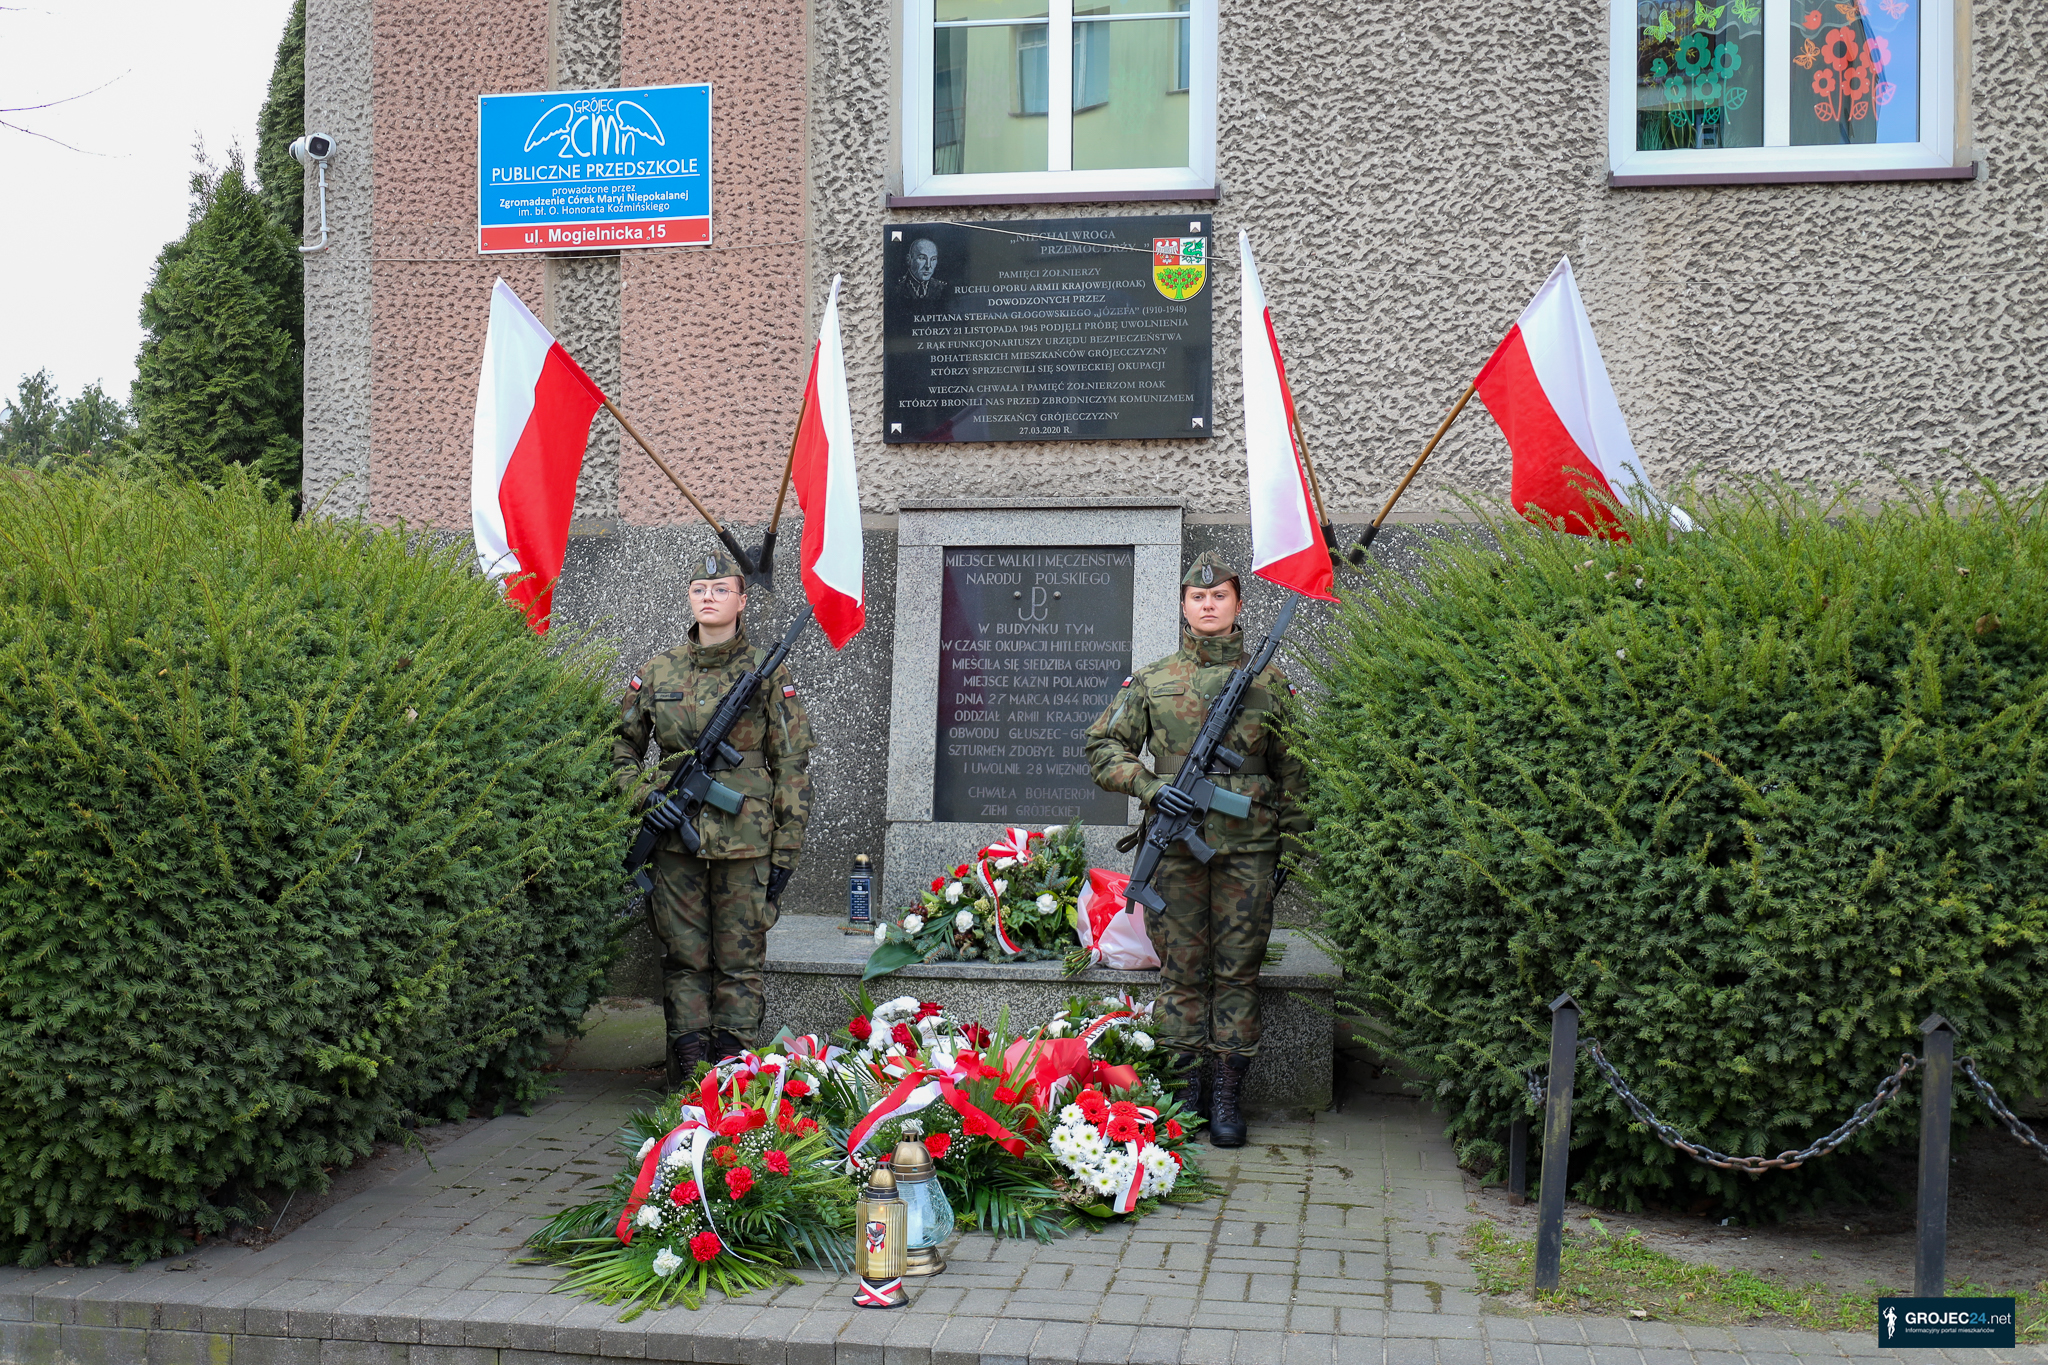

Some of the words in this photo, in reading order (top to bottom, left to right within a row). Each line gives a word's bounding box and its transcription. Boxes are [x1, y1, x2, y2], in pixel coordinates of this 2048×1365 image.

[574, 97, 614, 114] GRÓJEC
[492, 164, 580, 182] PUBLICZNE
[587, 158, 698, 177] PRZEDSZKOLE
[552, 186, 609, 197] prowadzone
[611, 184, 635, 194] przez
[500, 197, 565, 209] Zgromadzenie
[568, 195, 595, 205] Córek
[597, 194, 625, 205] Maryi
[627, 190, 689, 202] Niepokalanej
[518, 207, 533, 216] im.
[535, 206, 547, 216] bł.
[549, 206, 559, 215] O.
[562, 205, 605, 214] Honorata
[608, 202, 670, 213] Koźmińskiego
[525, 229, 543, 244] ul.
[549, 225, 643, 245] Mogielnicka
[648, 224, 666, 239] 15
[1072, 230, 1116, 240] WROGA
[1041, 244, 1099, 255] PRZEMOC
[999, 270, 1040, 280] PAMIĘCI
[1042, 267, 1101, 278] ŻOŁNIERZY
[954, 285, 990, 294] RUCHU
[992, 283, 1027, 293] OPORU
[1030, 282, 1059, 291] ARMII
[988, 295, 1070, 306] DOWODZONYCH
[1073, 295, 1106, 304] PRZEZ
[914, 313, 962, 323] KAPITANA
[964, 312, 1008, 321] STEFANA
[1011, 308, 1091, 320] GŁOGOWSKIEGO
[1142, 305, 1187, 316] (1910-1948)
[912, 327, 951, 337] KTÓRZY
[954, 327, 962, 335] 21
[965, 325, 1018, 335] LISTOPADA
[1021, 324, 1038, 332] 1945
[1040, 322, 1082, 333] PODJĘLI
[1084, 320, 1118, 331] PRÓBĘ
[1121, 318, 1189, 329] UWOLNIENIA
[917, 342, 924, 350] Z
[926, 341, 946, 351] RĄK
[948, 338, 1043, 349] FUNKCJONARIUSZY
[1045, 336, 1087, 347] URZĘDU
[1090, 332, 1183, 344] BEZPIECZEŃSTWA
[930, 352, 1008, 363] BOHATERSKICH
[1011, 348, 1086, 360] MIESZKAŃCÓW
[1088, 347, 1168, 359] GRÓJECCZYZNY
[930, 366, 970, 376] KTÓRZY
[972, 365, 1035, 375] SPRZECIWILI
[1038, 364, 1053, 374] SIĘ
[1056, 362, 1115, 372] SOWIECKIEJ
[1117, 361, 1165, 371] OKUPACJI
[928, 385, 974, 394] WIECZNA
[977, 384, 1018, 393] CHWAŁA
[1027, 381, 1065, 392] PAMIĘĆ
[1067, 381, 1136, 391] ŻOŁNIERZOM
[1138, 380, 1166, 389] ROAK
[899, 398, 939, 408] KTÓRZY
[941, 399, 983, 407] BRONILI
[986, 398, 1005, 406] NAS
[1007, 397, 1040, 405] PRZED
[1042, 395, 1117, 404] ZBRODNICZYM
[1120, 394, 1194, 403] KOMUNIZMEM
[973, 412, 1038, 423] MIESZKAŃCY
[1040, 412, 1120, 422] GRÓJECCZYZNY
[1019, 426, 1061, 435] 27.03.2020
[1063, 426, 1072, 434] R.
[945, 554, 995, 567] MIEJSCE
[998, 554, 1035, 567] WALKI
[1037, 554, 1041, 567] I
[1045, 552, 1133, 568] MĘCZEŃSTWA
[966, 572, 1022, 585] NARODU
[1035, 572, 1110, 585] POLSKIEGO
[978, 623, 990, 635] W
[996, 623, 1059, 635] BUDYNKU
[1065, 623, 1094, 635] TYM
[941, 639, 952, 651] W
[954, 639, 992, 652] CZASIE
[995, 639, 1048, 652] OKUPACJI
[1051, 640, 1132, 652] HITLEROWSKIEJ
[952, 655, 1001, 670] MIEŚCIŁA
[1003, 658, 1020, 673] SIĘ
[1023, 658, 1072, 671] SIEDZIBA
[1075, 659, 1121, 671] GESTAPO
[963, 675, 1009, 688] MIEJSCE
[1053, 673, 1109, 688] POLAKÓW
[956, 692, 984, 705] DNIA
[988, 693, 1007, 705] 27
[1009, 693, 1050, 705] MARCA
[1053, 693, 1080, 705] 1944
[1082, 693, 1114, 706] ROKU
[954, 710, 1001, 722] ODDZIAŁ
[1007, 711, 1039, 722] ARMII
[949, 727, 999, 739] OBWODU
[948, 744, 1006, 757] SZTURMEM
[1008, 745, 1055, 757] ZDOBYŁ
[1062, 745, 1087, 758] BUD
[963, 762, 967, 774] I
[971, 763, 1021, 775] UWOLNIŁ
[1026, 763, 1043, 775] 28
[968, 786, 1017, 799] CHWAŁA
[1025, 787, 1095, 800] BOHATEROM
[981, 804, 1008, 816] ZIEMI
[1015, 803, 1081, 817] GRÓJECKIEJ
